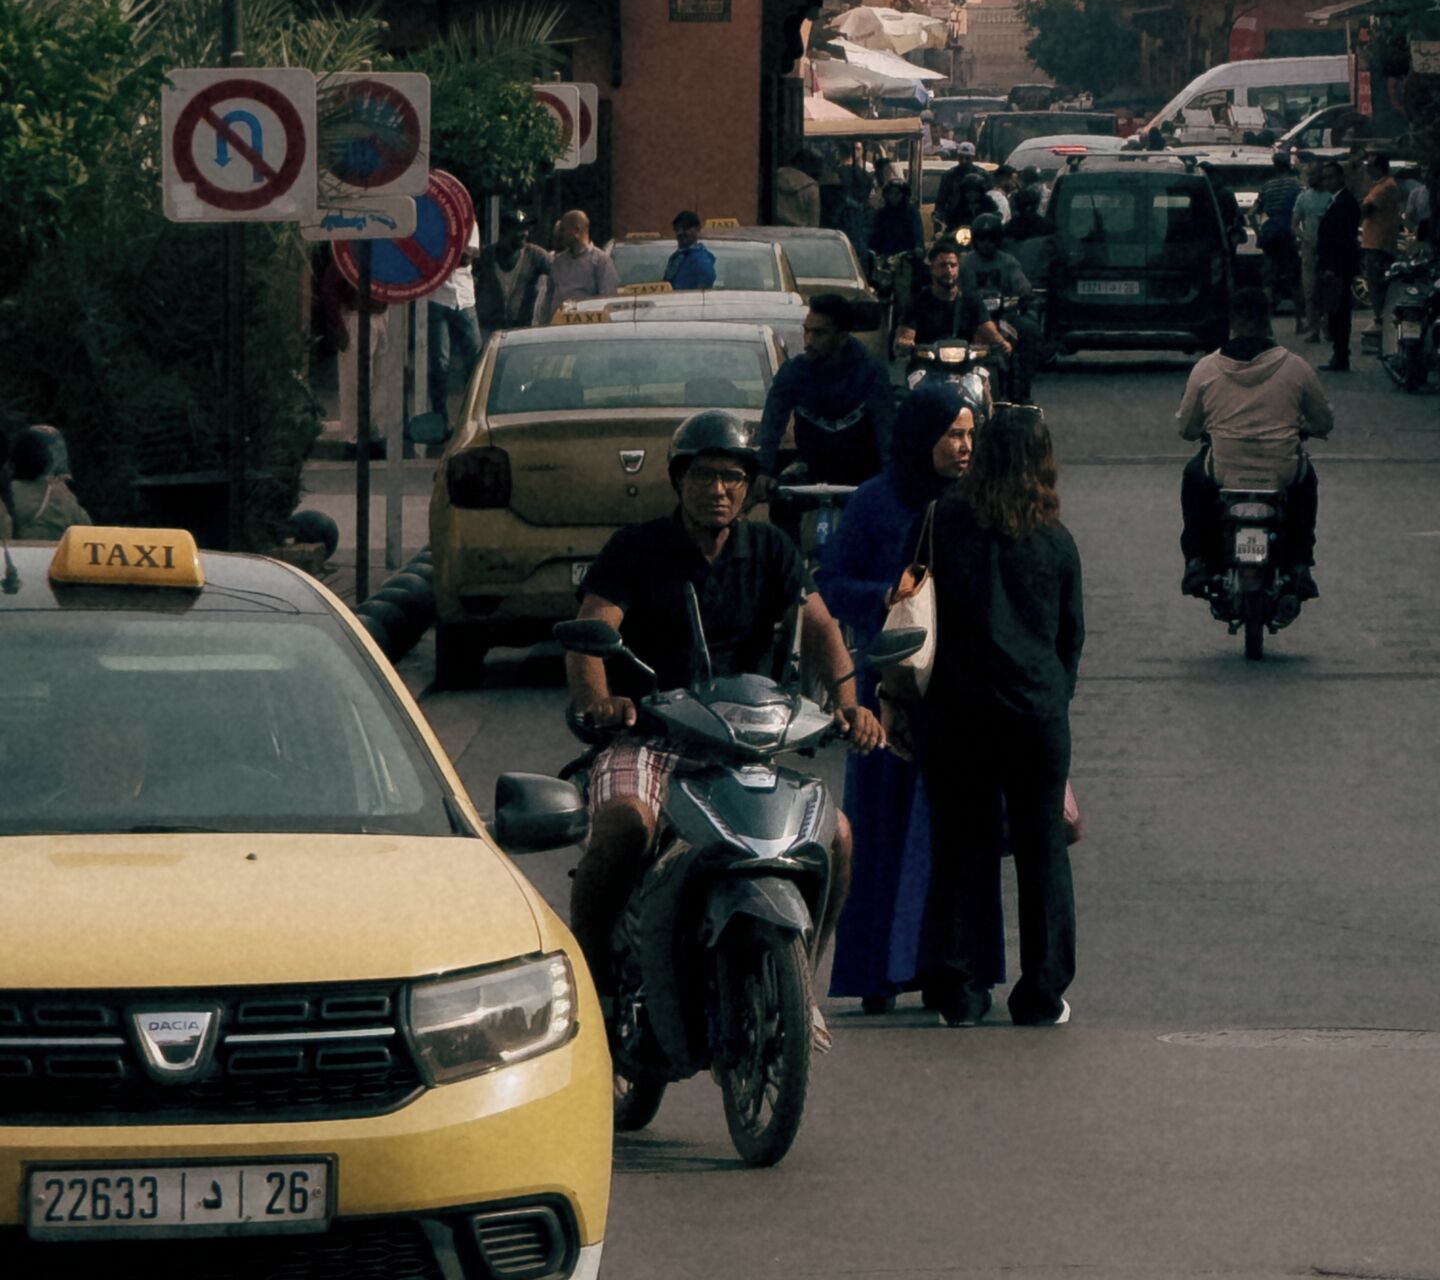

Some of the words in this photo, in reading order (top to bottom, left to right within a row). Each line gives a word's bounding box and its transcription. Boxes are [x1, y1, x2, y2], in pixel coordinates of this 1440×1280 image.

[563, 313, 603, 324] TAXI
[83, 542, 176, 569] TAXI
[148, 1020, 199, 1031] DACIA
[44, 1175, 158, 1222] 22633
[265, 1170, 310, 1215] 26
